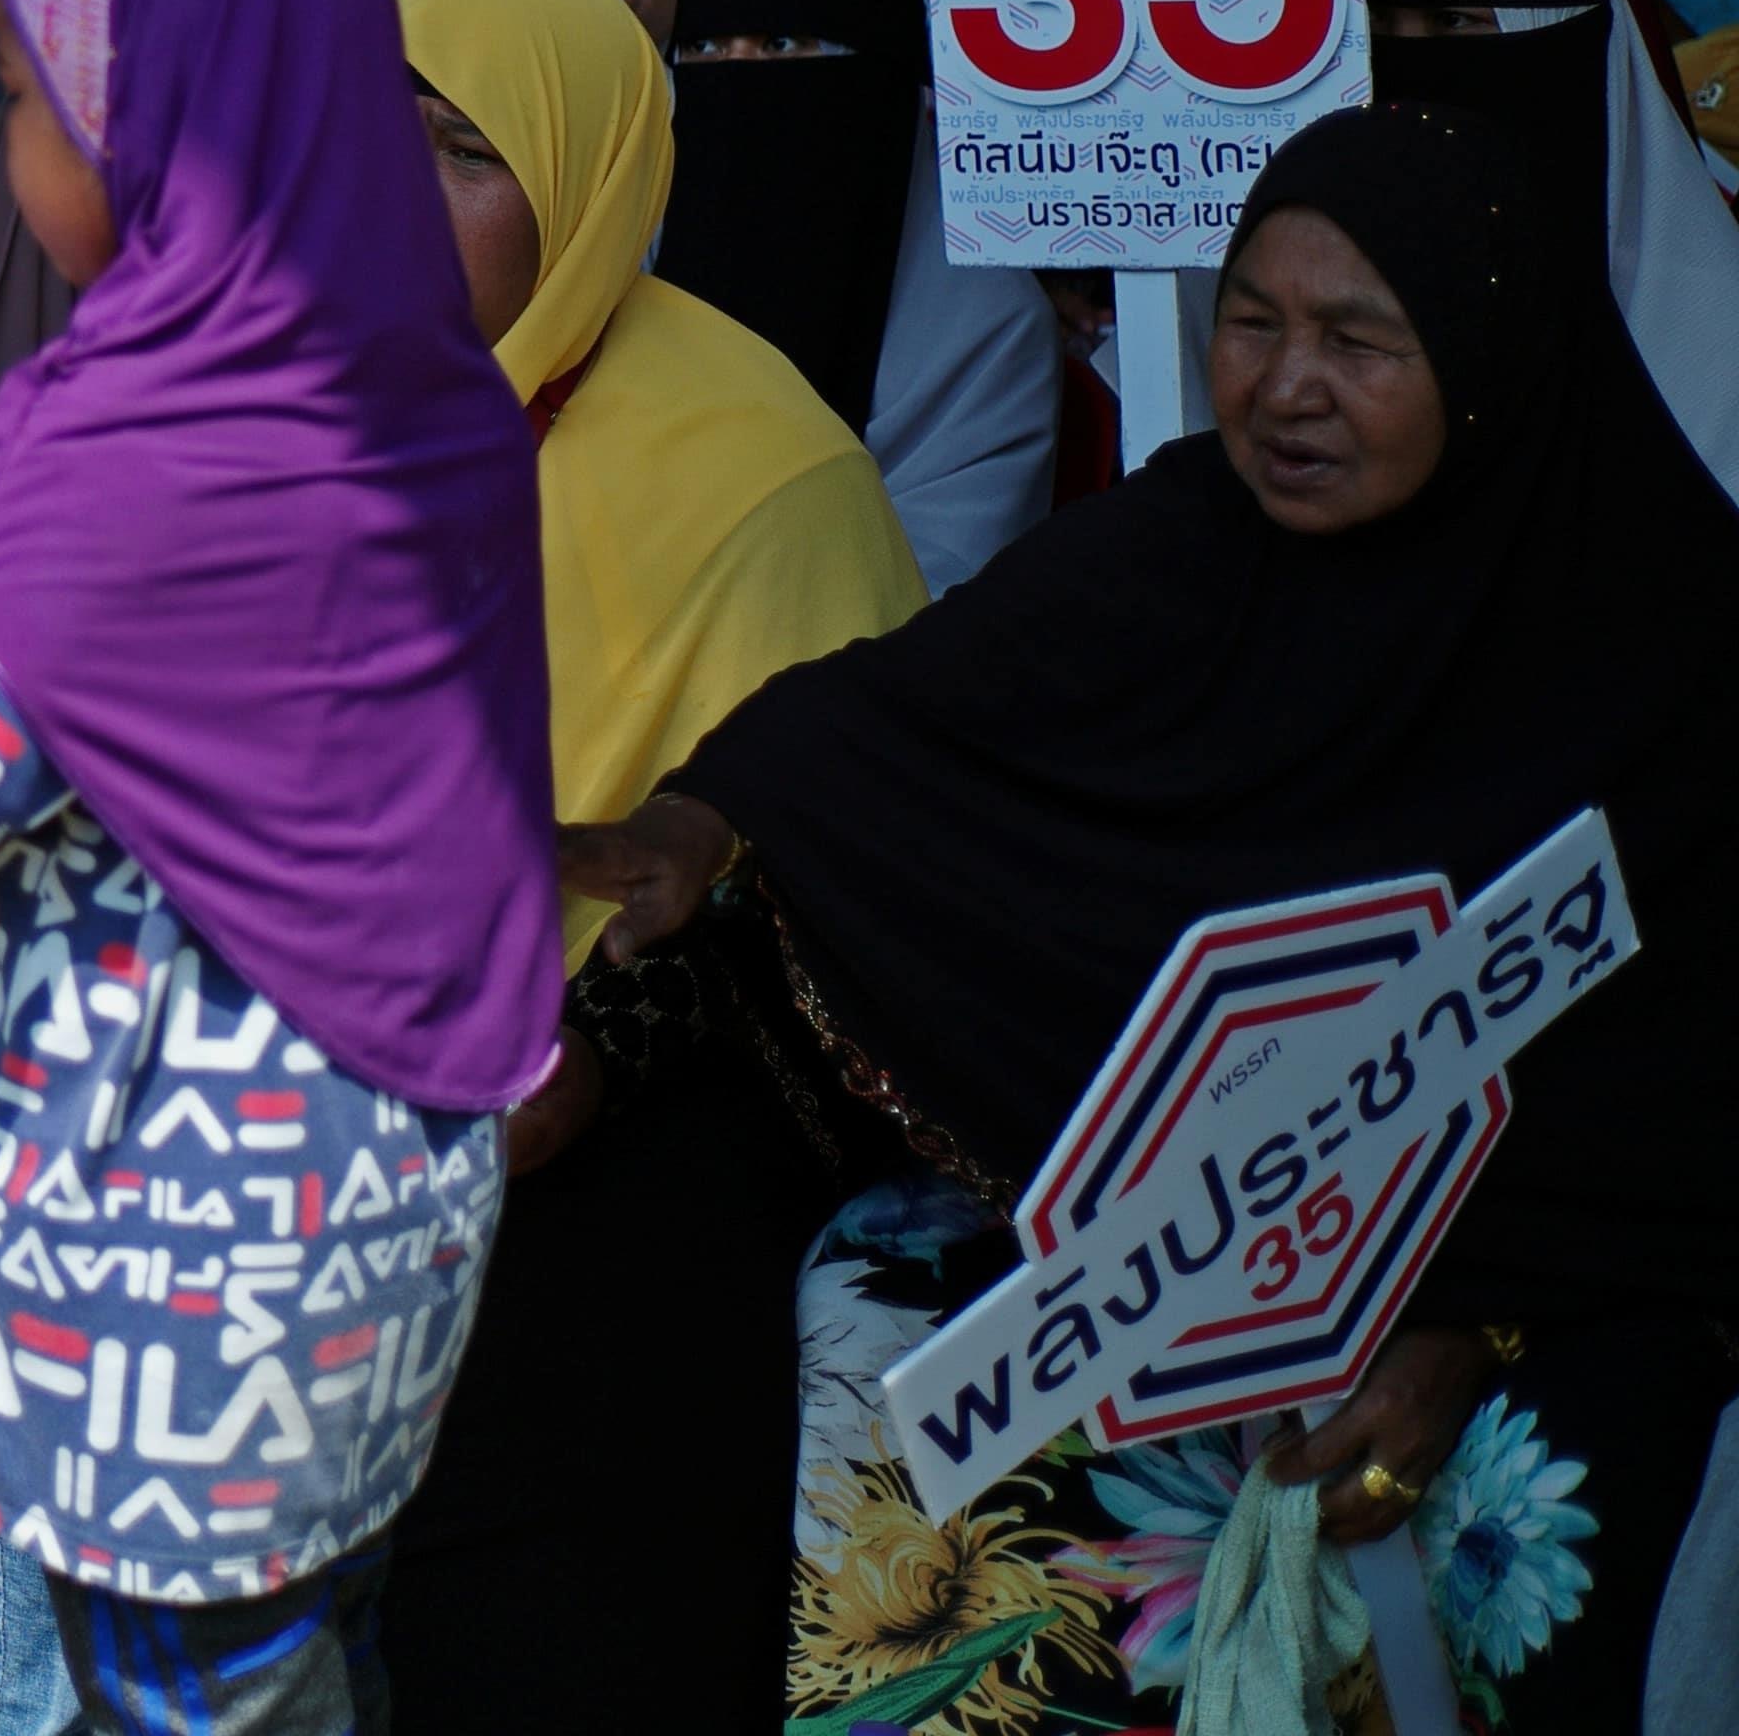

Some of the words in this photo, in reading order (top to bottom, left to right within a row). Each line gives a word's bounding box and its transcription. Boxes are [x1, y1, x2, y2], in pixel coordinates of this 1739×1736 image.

[954, 130, 1075, 173] ตัสนีม
[1096, 129, 1181, 187] เจ๊ะตู
[1028, 195, 1176, 227] นราธิวาส
[1208, 1037, 1281, 1104] พรรค
[917, 861, 1616, 1467] พลังประชารัฐ
[103, 1170, 235, 1227] FILA
[1242, 1172, 1356, 1302] 35
[10, 1312, 315, 1463] FILA
